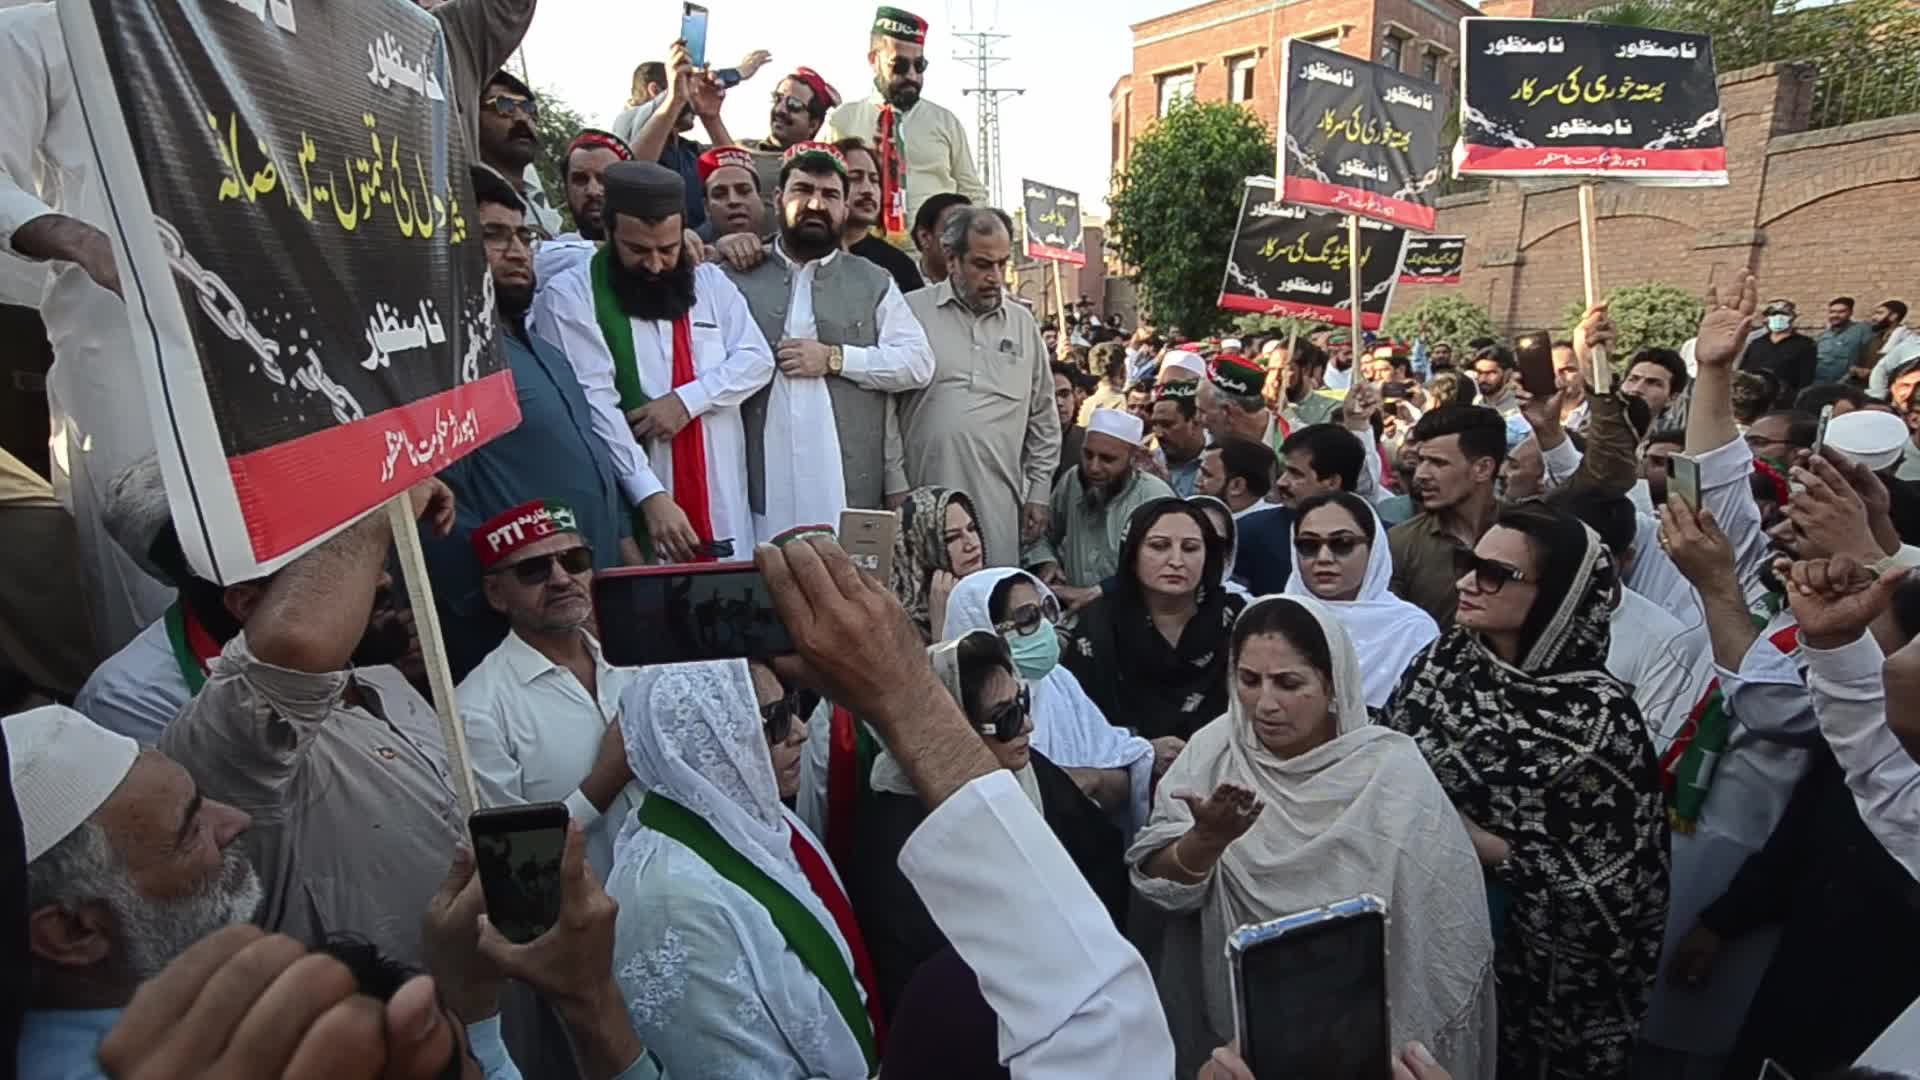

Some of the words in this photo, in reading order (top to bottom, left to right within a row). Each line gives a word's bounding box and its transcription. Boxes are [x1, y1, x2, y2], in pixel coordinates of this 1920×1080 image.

[1483, 35, 1565, 56] نامنظور
[1614, 38, 1697, 59] نامنظور
[1299, 60, 1355, 88] نامنظور
[1557, 64, 1584, 105] کی
[1383, 84, 1434, 111] نامنظور
[1510, 77, 1560, 107] سرکار
[1345, 103, 1364, 142] کی
[1545, 117, 1633, 139] نامنظور
[1336, 157, 1389, 182] نامنظور
[1276, 276, 1334, 295] نامنظور
[359, 298, 447, 371] نامنظور
[486, 520, 525, 553] PTI
